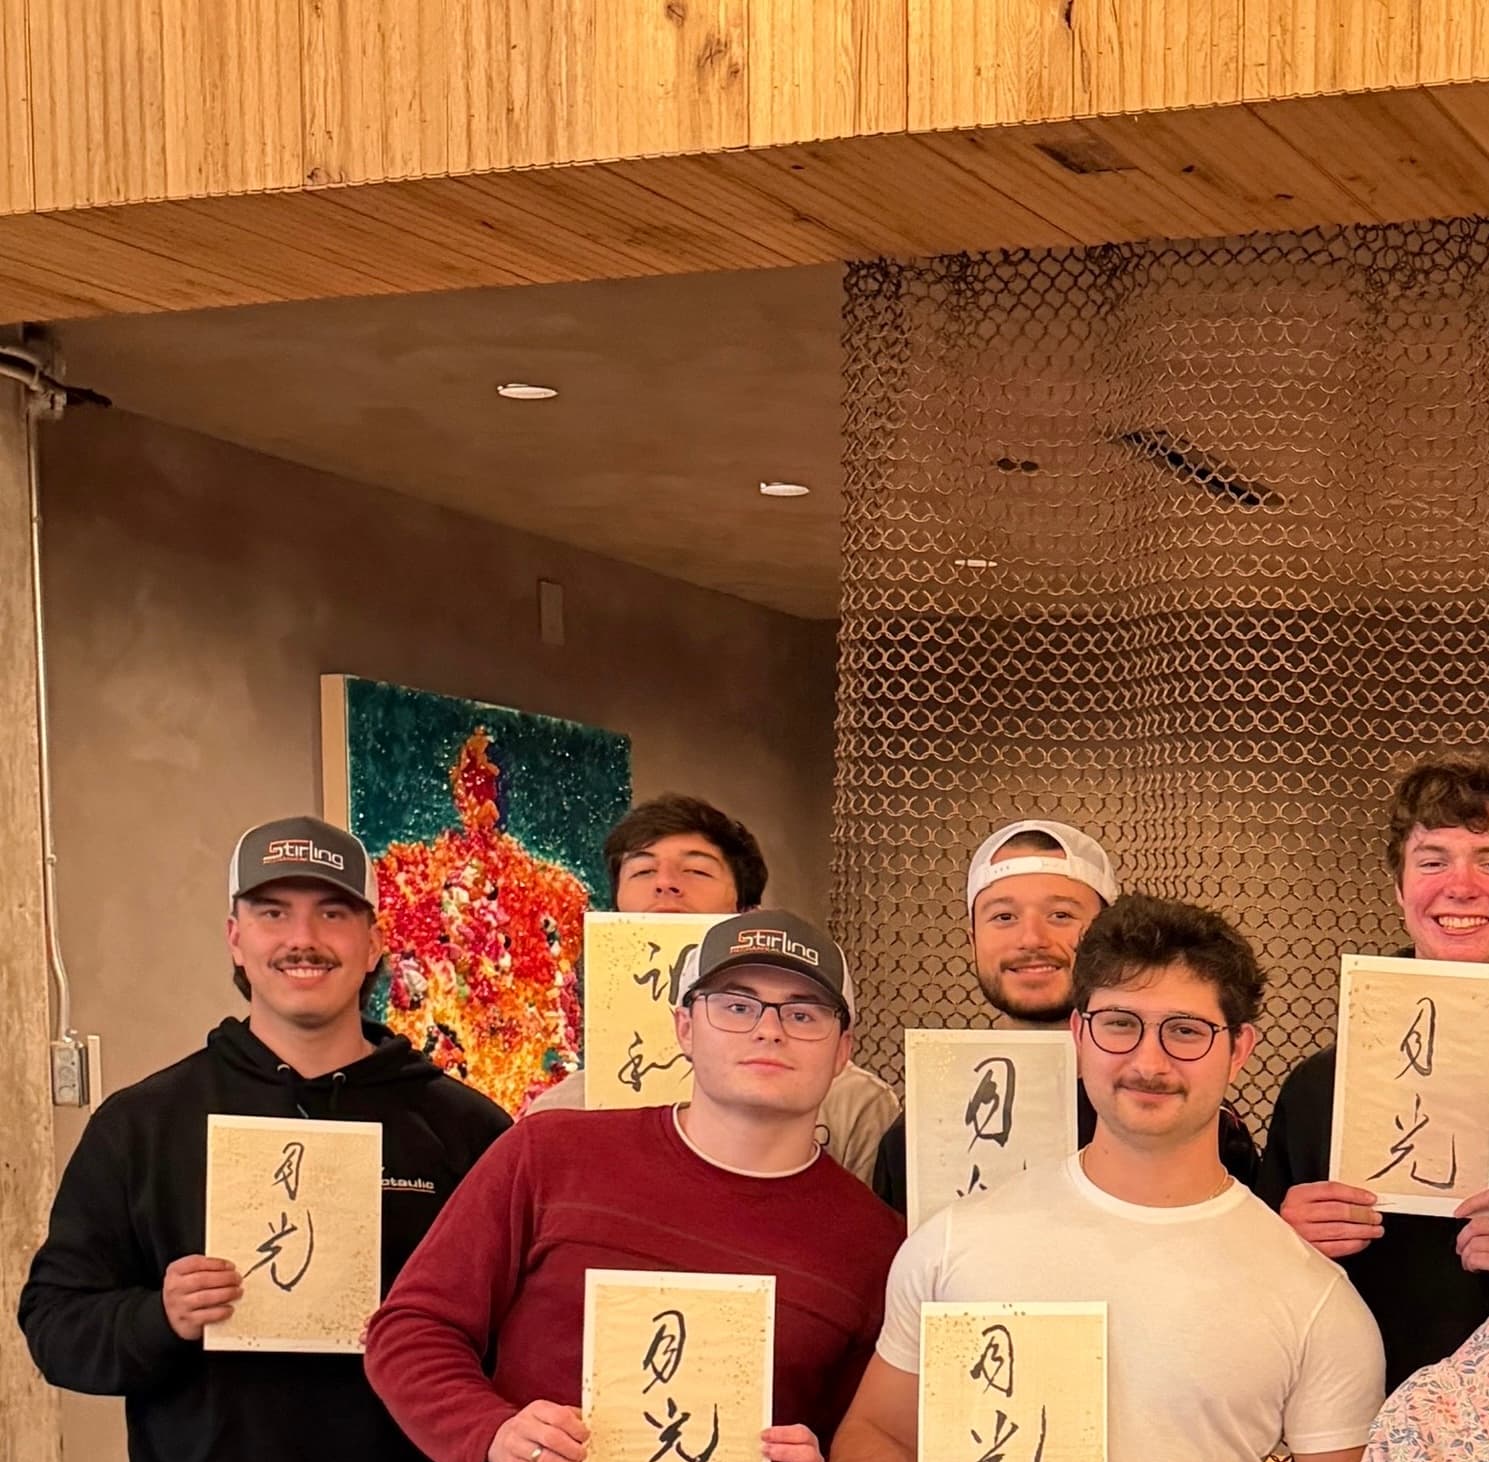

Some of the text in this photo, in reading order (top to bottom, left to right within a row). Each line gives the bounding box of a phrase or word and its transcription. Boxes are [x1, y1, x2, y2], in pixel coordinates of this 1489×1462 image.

[956, 1056, 1027, 1197] 月
[1365, 996, 1457, 1190] 月光
[242, 1141, 314, 1292] 月光
